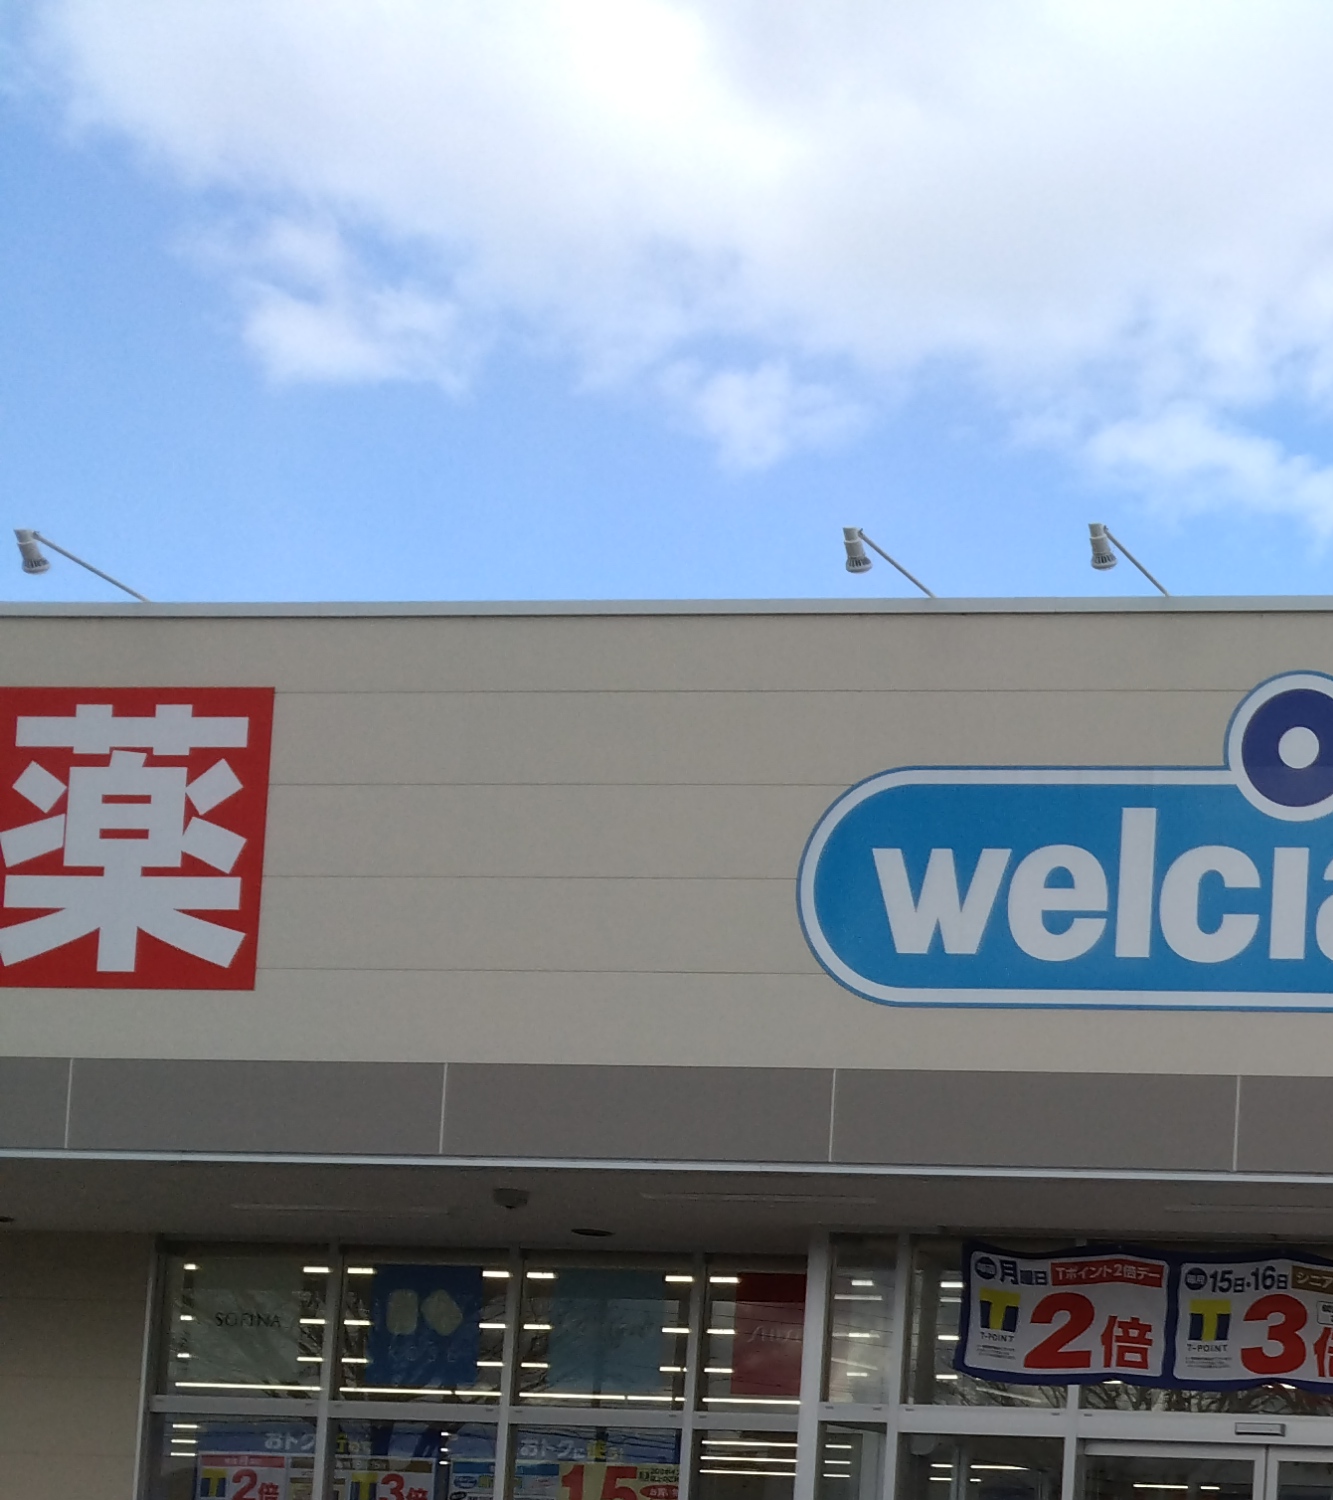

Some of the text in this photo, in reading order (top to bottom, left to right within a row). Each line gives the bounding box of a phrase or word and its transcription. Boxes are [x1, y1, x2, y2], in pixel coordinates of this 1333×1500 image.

[0, 703, 250, 973] 薬
[1055, 1263, 1161, 1281] Tポイント2倍デー
[214, 1311, 282, 1329] SOFINA
[1023, 1291, 1154, 1370] 2倍
[1187, 1343, 1229, 1353] T-POINT
